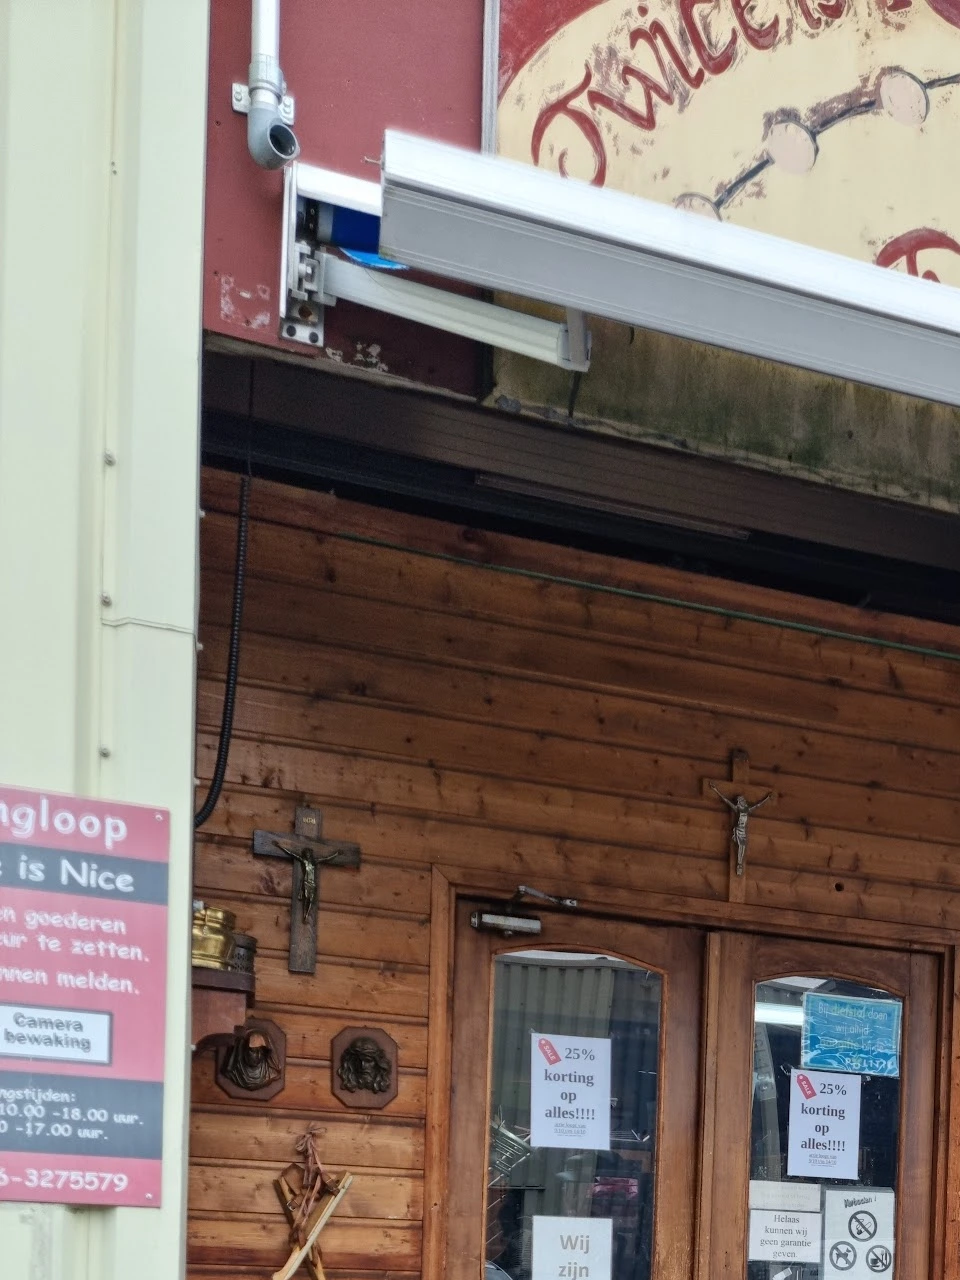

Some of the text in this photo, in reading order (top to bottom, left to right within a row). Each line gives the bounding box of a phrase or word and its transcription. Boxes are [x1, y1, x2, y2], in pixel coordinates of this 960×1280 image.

[19, 854, 135, 893] is Nice
[24, 909, 126, 935] goederen
[36, 934, 62, 951] te
[71, 938, 150, 962] zetten.
[56, 970, 140, 995] melden.
[818, 1002, 829, 1018] Bij
[868, 1008, 888, 1020] doen
[13, 1012, 84, 1032] Camera
[4, 1028, 91, 1053] bewaking
[543, 1045, 556, 1061] SALE
[564, 1047, 595, 1061] 25%
[544, 1069, 594, 1087] korting
[801, 1080, 812, 1095] SALE
[819, 1083, 847, 1096] 25%
[560, 1091, 577, 1104] op
[113, 1113, 144, 1125] uur.
[545, 1106, 595, 1120] alles!!!!
[801, 1103, 845, 1120] korting
[77, 1128, 108, 1140] uur.
[814, 1124, 829, 1136] op
[800, 1138, 845, 1151] alles!!!!
[773, 1214, 800, 1223] Helaas
[764, 1226, 808, 1237] kunnen wij
[560, 1235, 590, 1254] Wij
[760, 1238, 812, 1247] geen garantie
[772, 1250, 798, 1258] geven.
[558, 1262, 589, 1280] zijn
